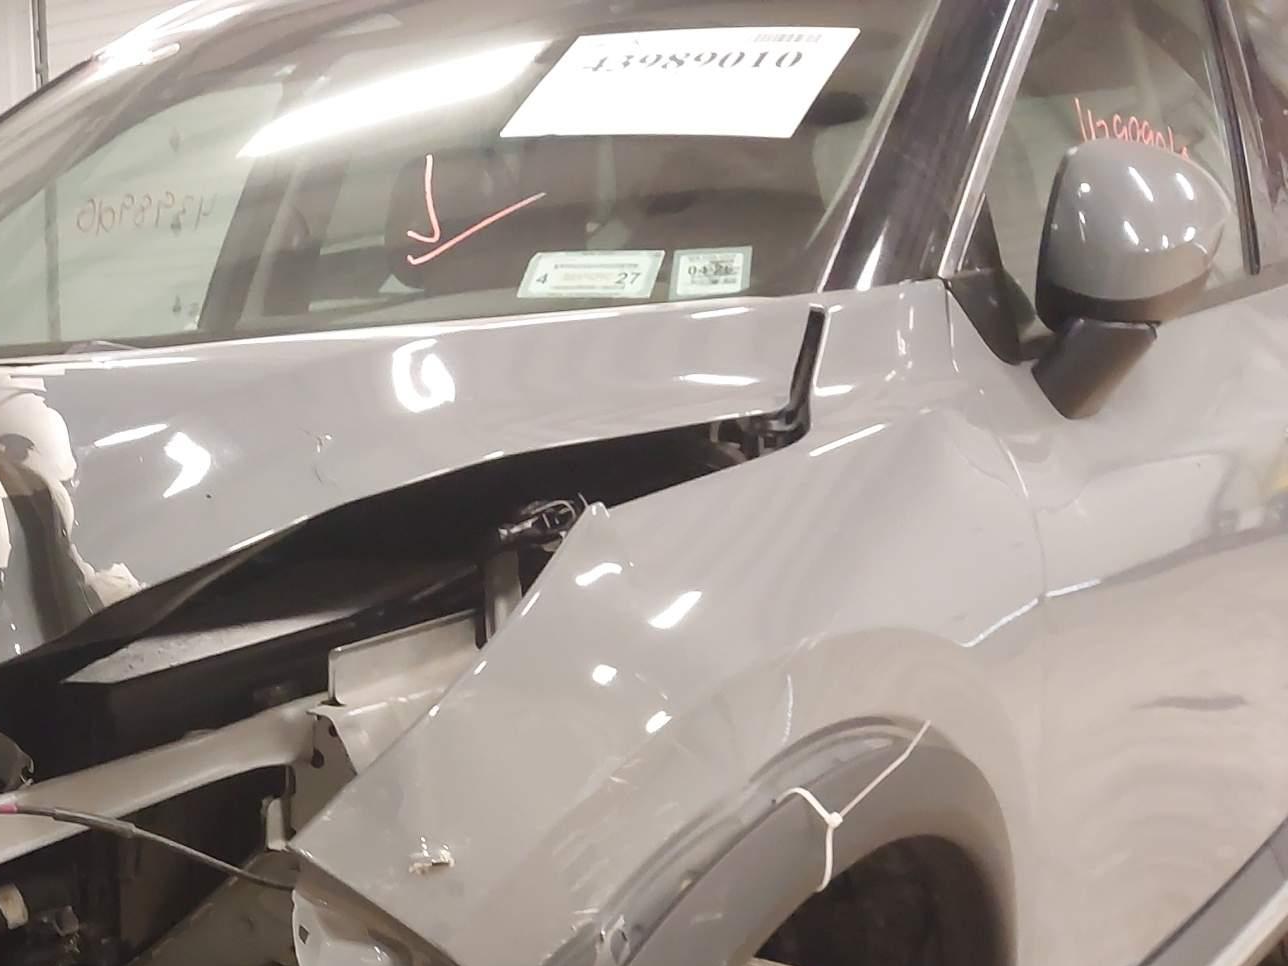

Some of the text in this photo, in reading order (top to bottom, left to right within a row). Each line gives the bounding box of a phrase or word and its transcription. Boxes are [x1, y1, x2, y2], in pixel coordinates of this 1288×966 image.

[582, 50, 803, 73] 43989010
[535, 272, 642, 285] 4 27
